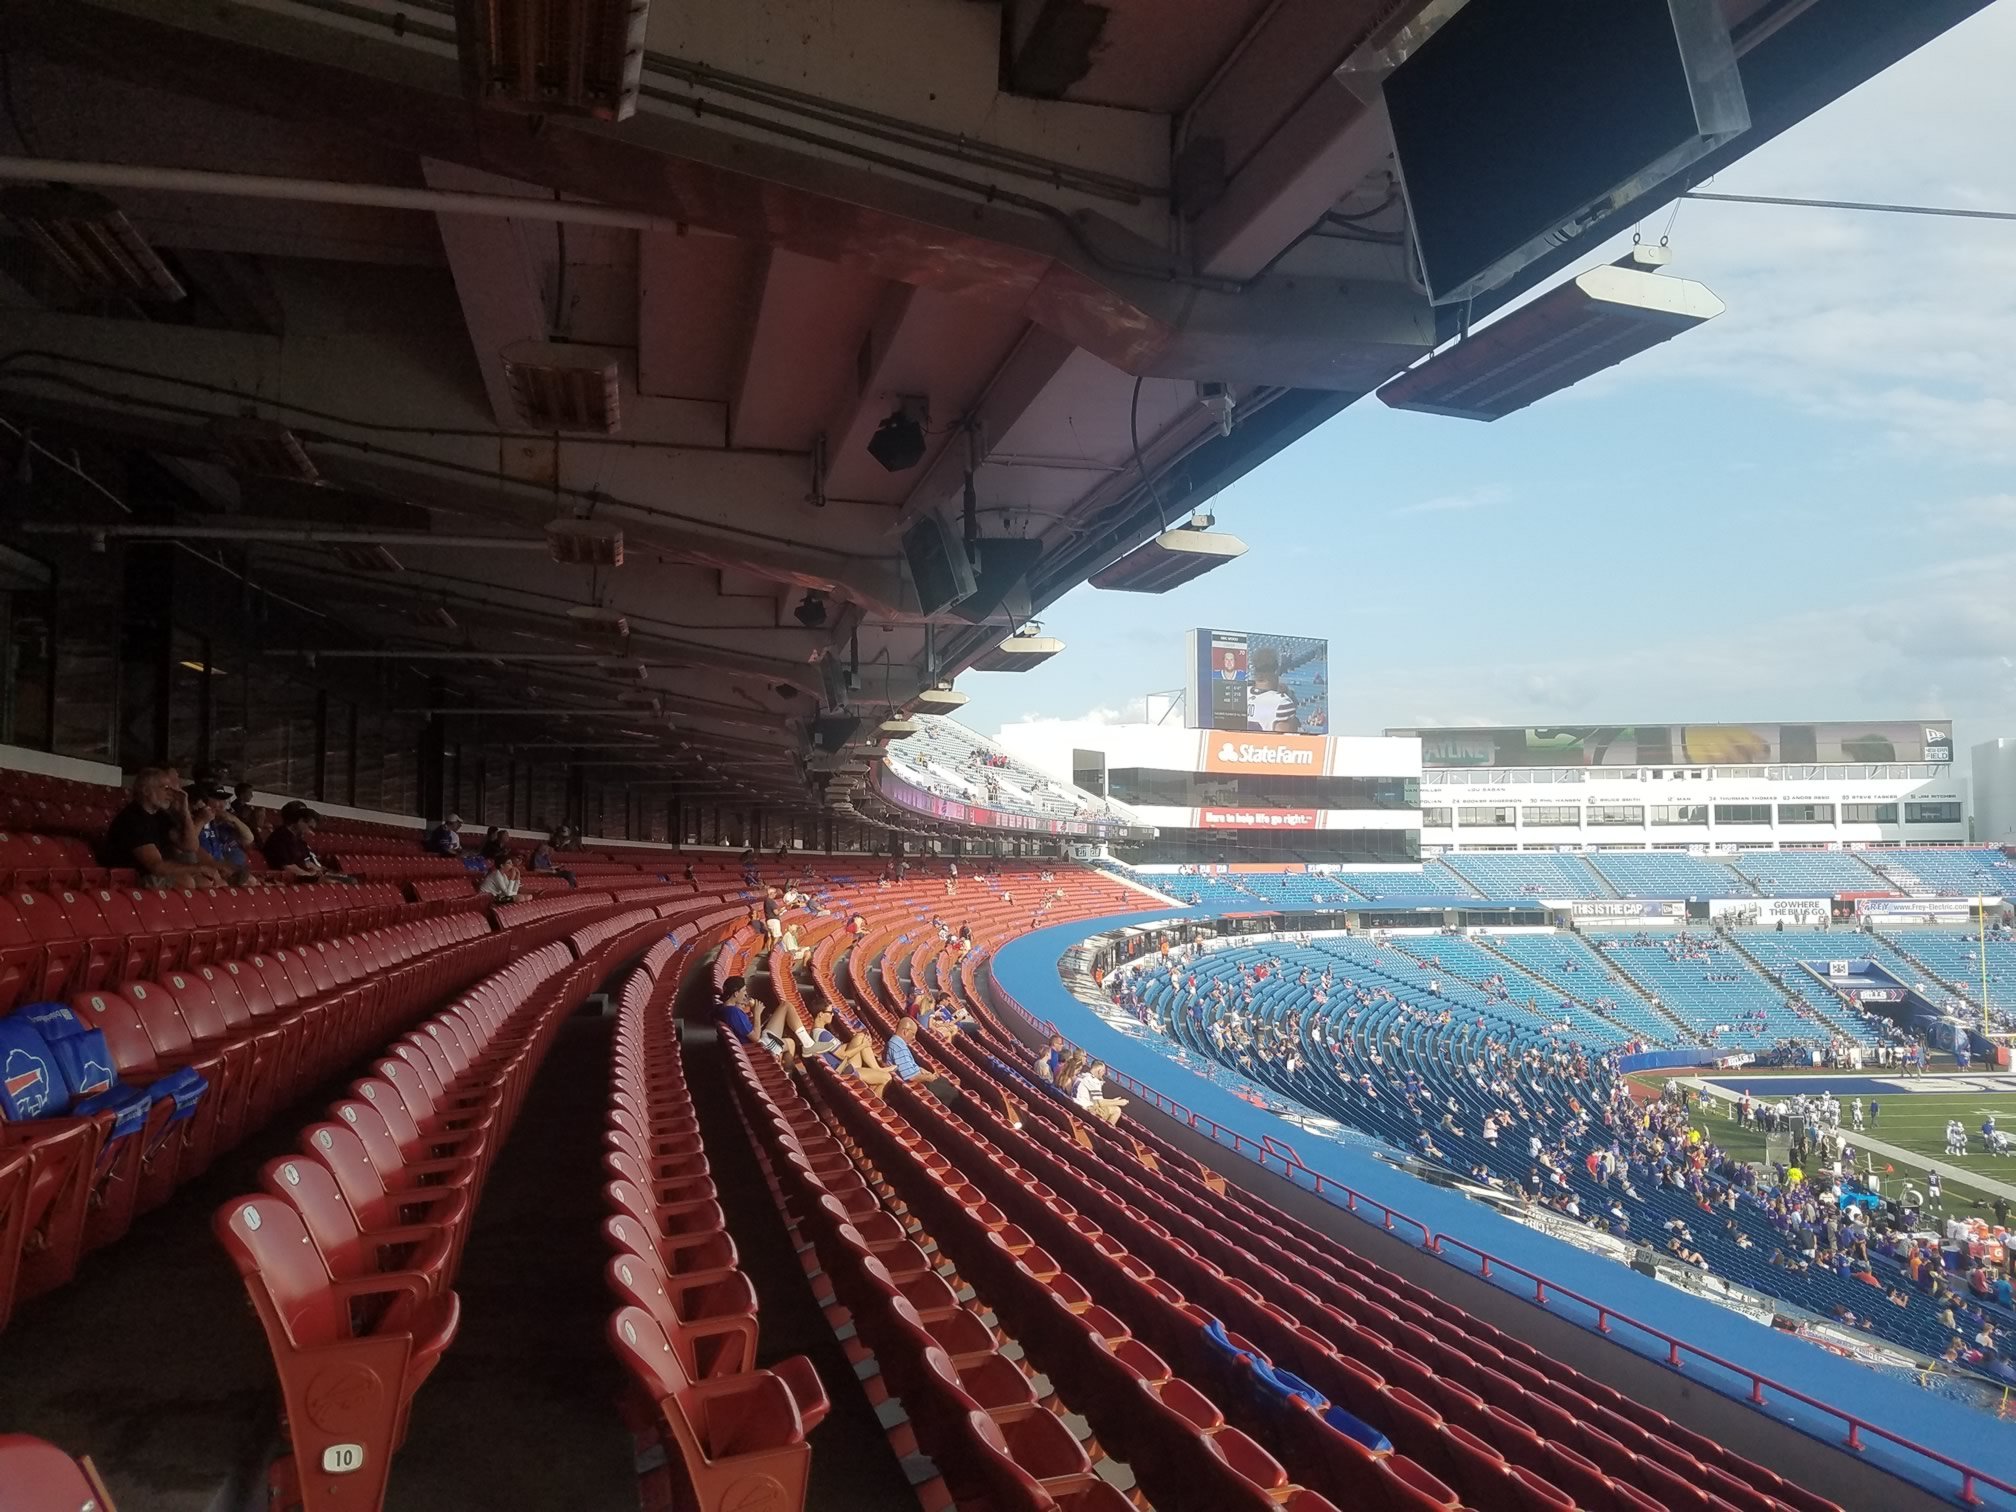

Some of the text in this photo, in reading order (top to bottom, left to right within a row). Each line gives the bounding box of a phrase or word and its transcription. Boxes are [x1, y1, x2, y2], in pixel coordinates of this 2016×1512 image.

[1573, 904, 1643, 915] THIS IS THE CAP
[1894, 904, 1969, 912] www.Frey-Electric.com
[336, 1449, 352, 1467] 10
